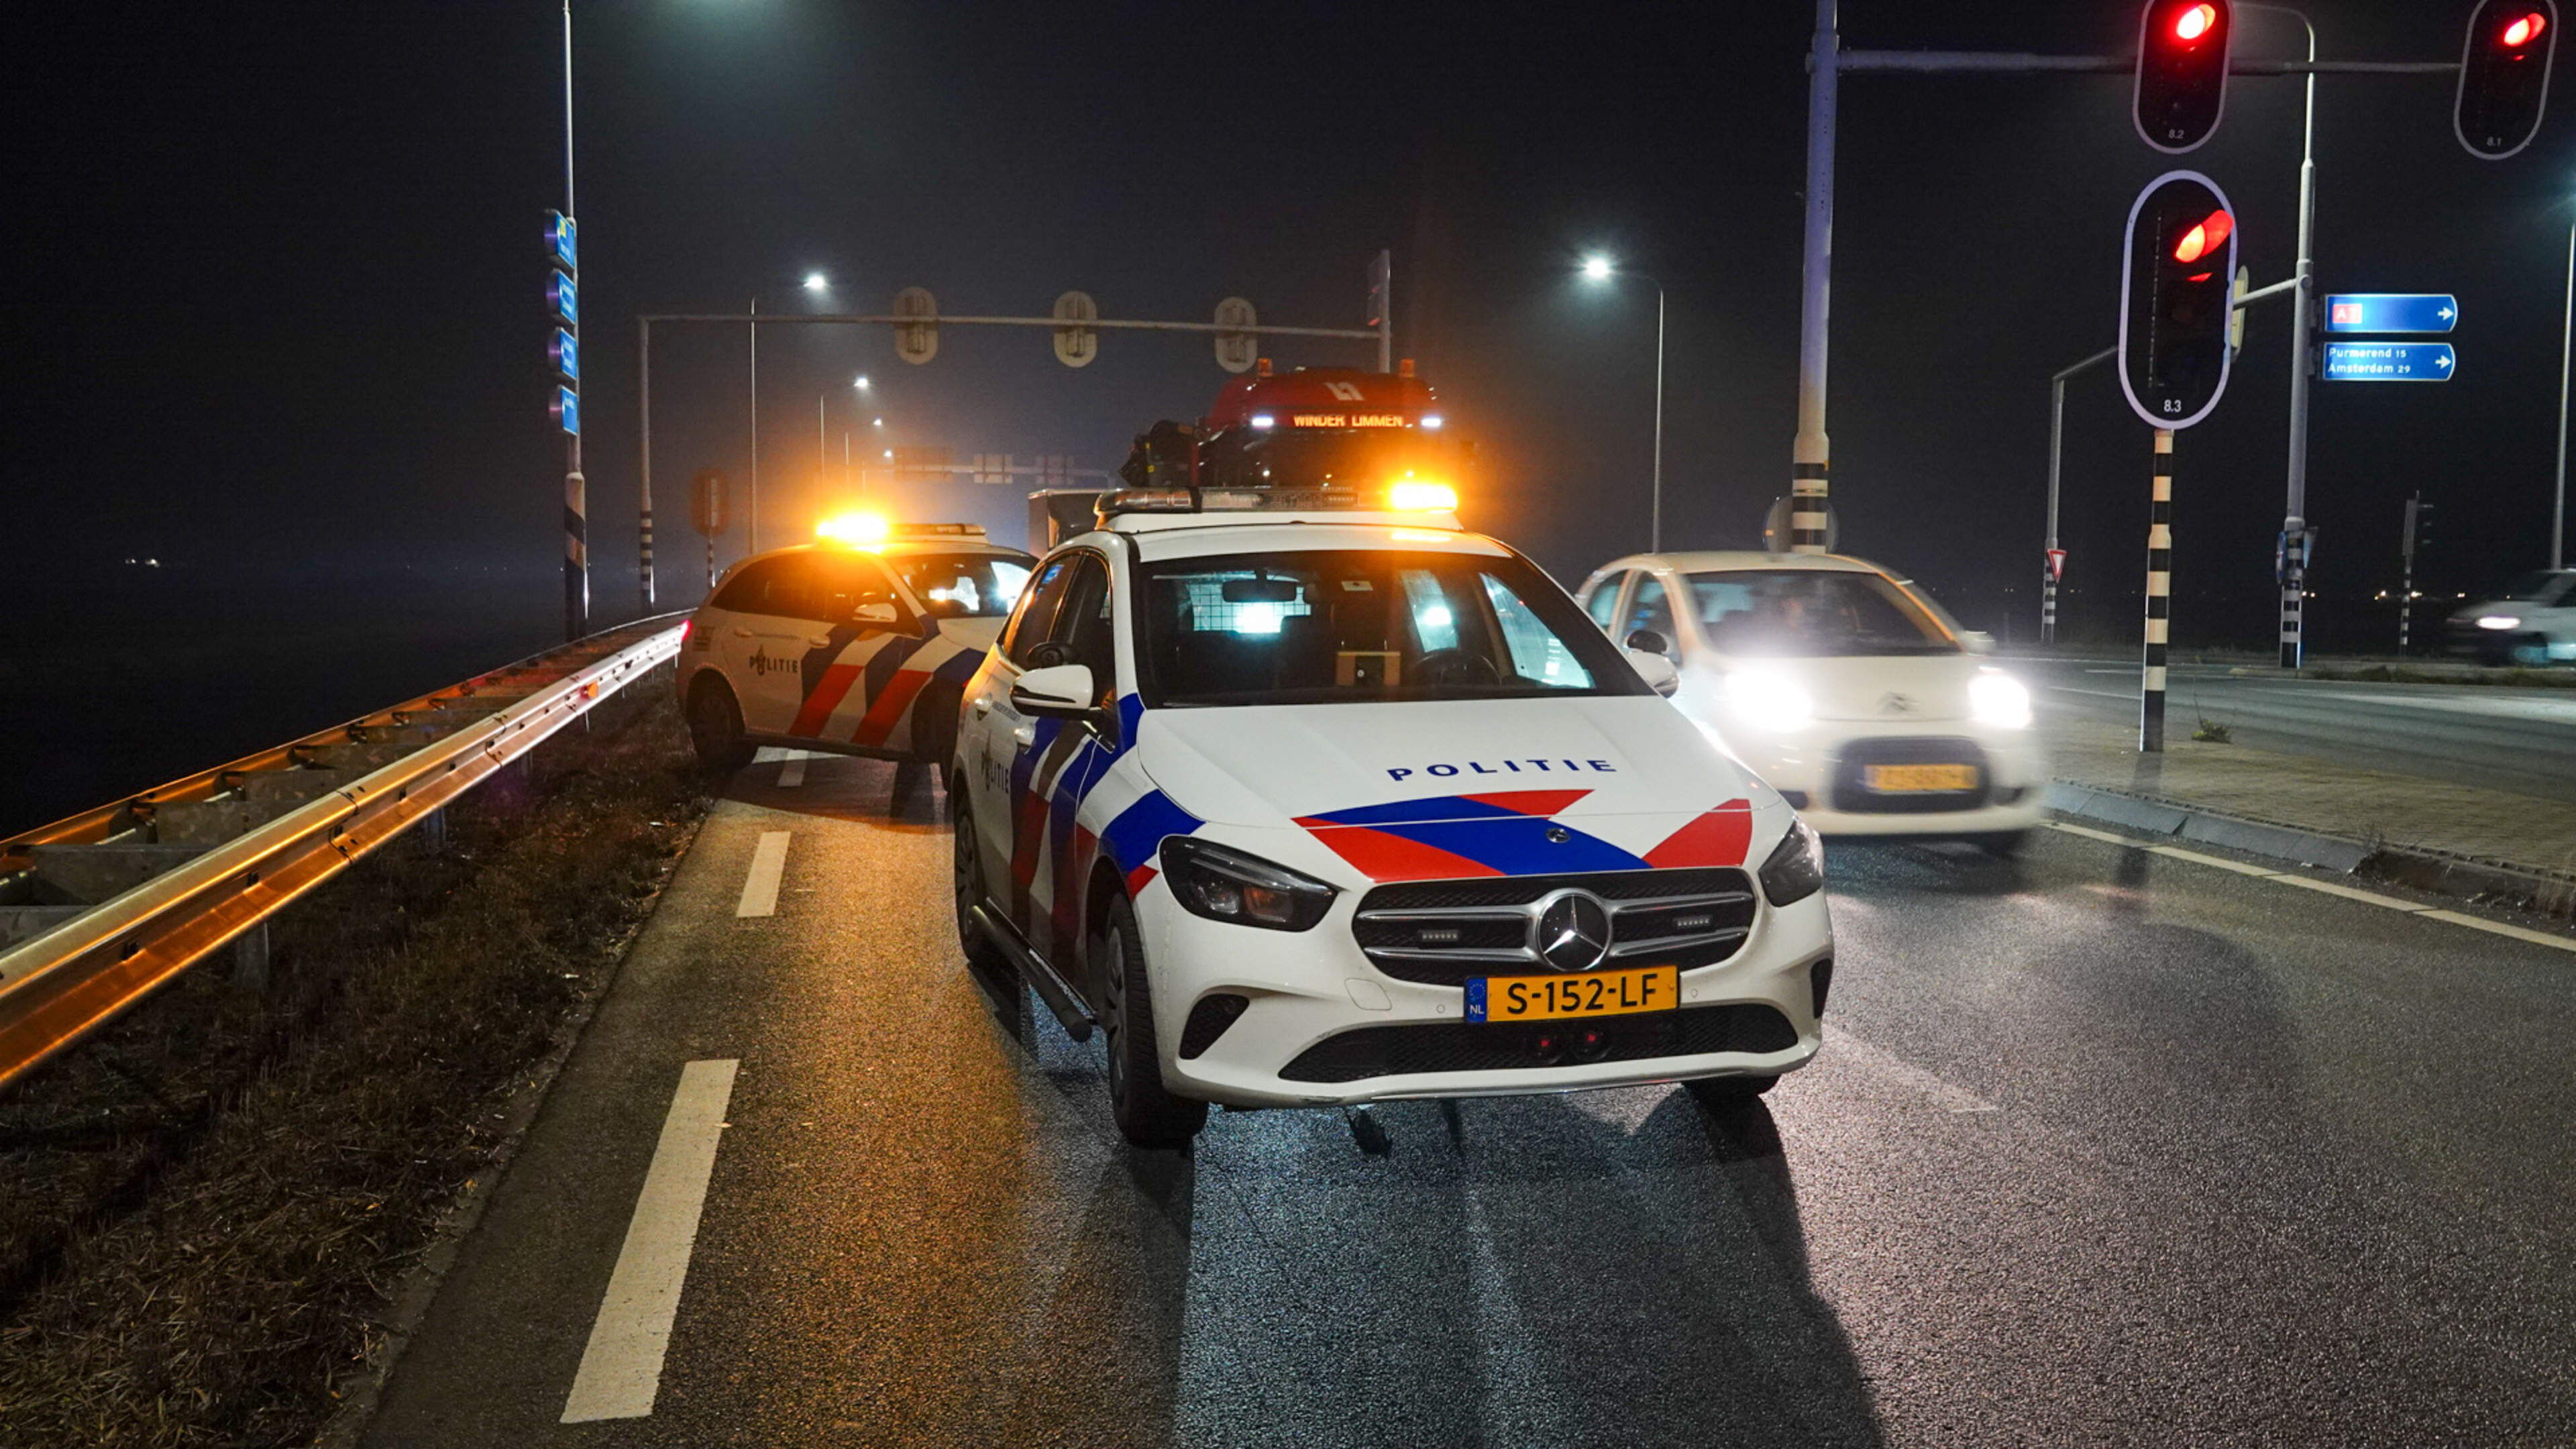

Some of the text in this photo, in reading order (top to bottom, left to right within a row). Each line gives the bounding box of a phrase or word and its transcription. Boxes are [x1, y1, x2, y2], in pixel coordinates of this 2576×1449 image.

[2168, 128, 2184, 139] 8.2
[2329, 347, 2406, 358] Purmerend 15
[2328, 363, 2410, 374] Amsterdam 29
[2163, 399, 2182, 413] 8.3
[1293, 415, 1403, 427] WINDER LIMMEN
[749, 651, 798, 676] POLITIE
[1386, 759, 1617, 782] POLITIE
[1507, 973, 1658, 1015] S-152-LF
[1470, 1005, 1485, 1015] NL
